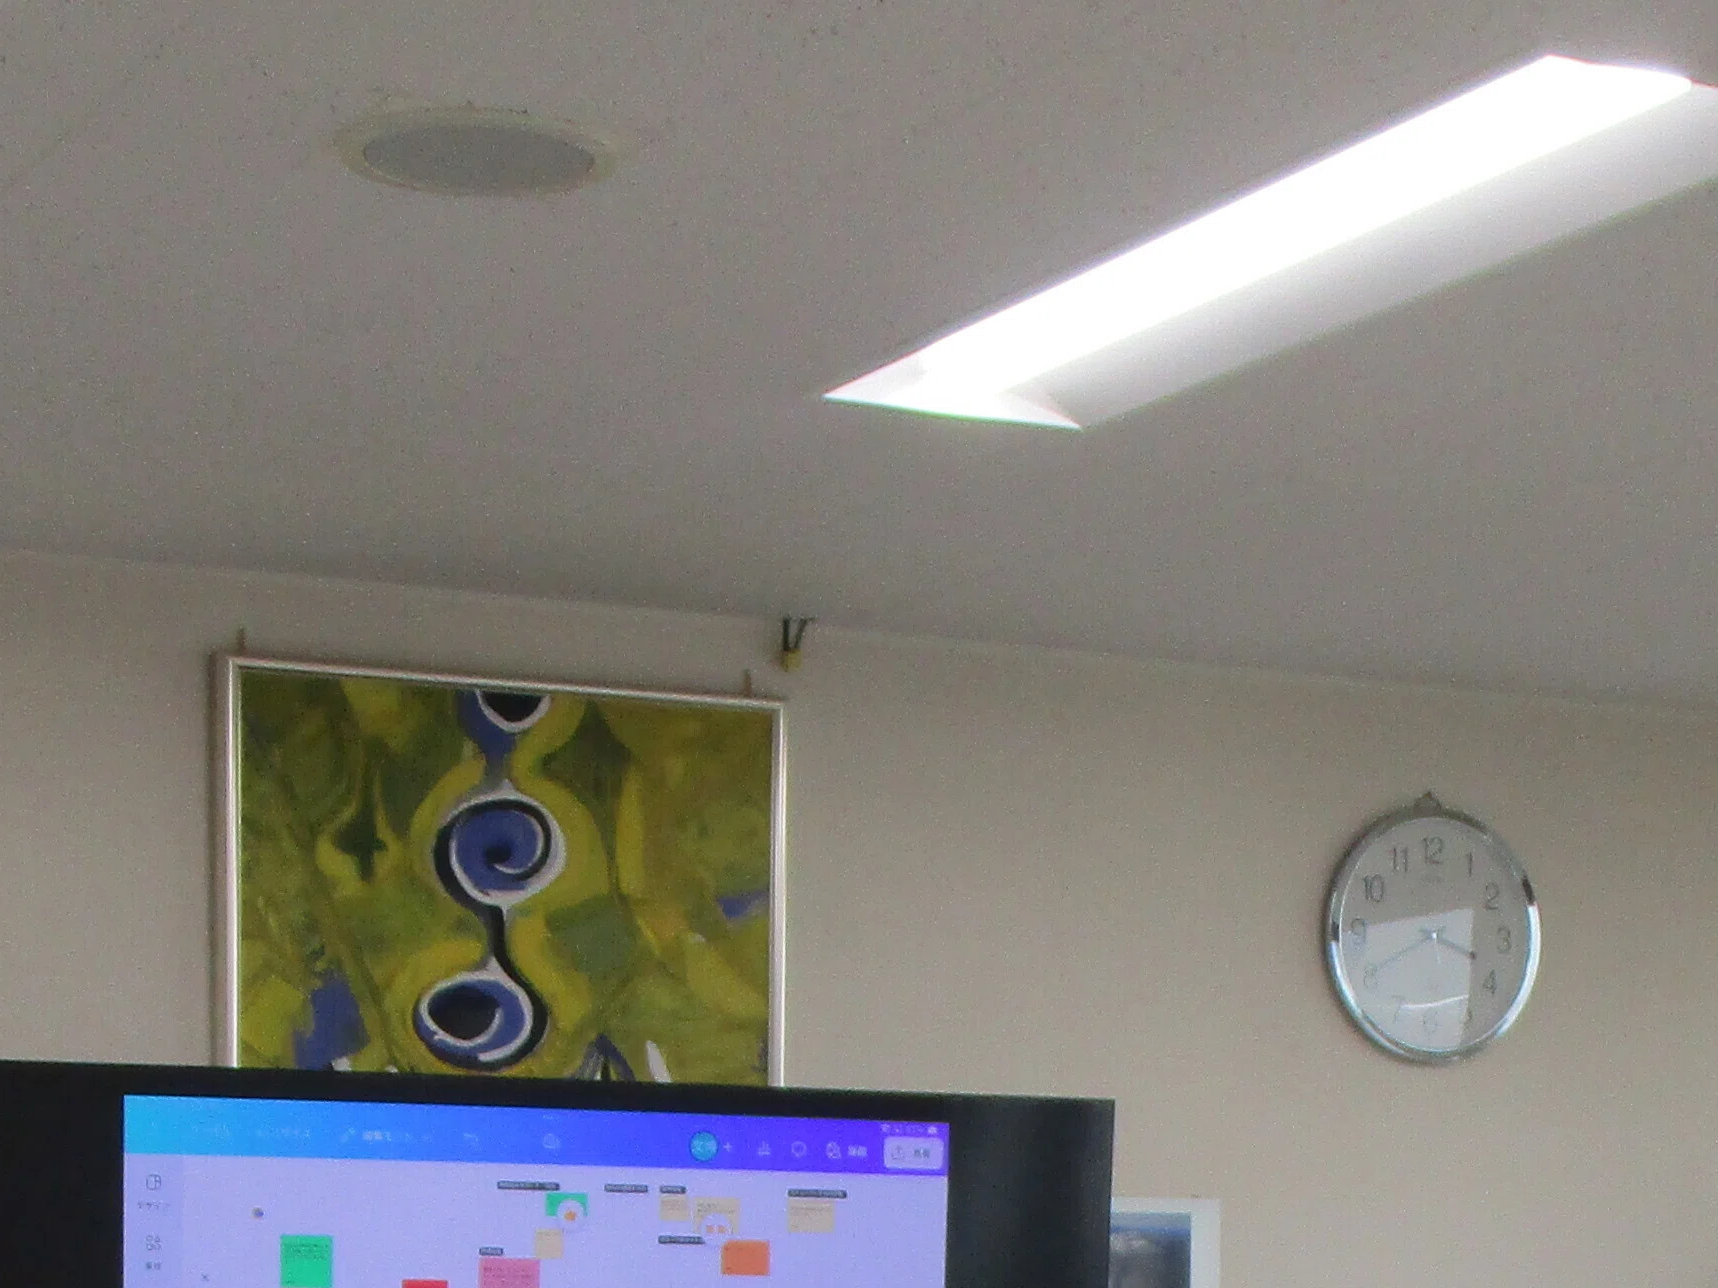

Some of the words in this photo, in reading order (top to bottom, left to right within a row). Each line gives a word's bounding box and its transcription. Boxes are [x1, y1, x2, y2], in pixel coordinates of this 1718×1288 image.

[1391, 847, 1409, 873] 11
[1421, 836, 1444, 865] 12
[1466, 852, 1475, 877] 1
[1363, 873, 1384, 903] 10
[1484, 883, 1499, 911] 2
[1351, 917, 1367, 946] 9
[1497, 927, 1512, 954] 3
[1484, 970, 1497, 995] 4
